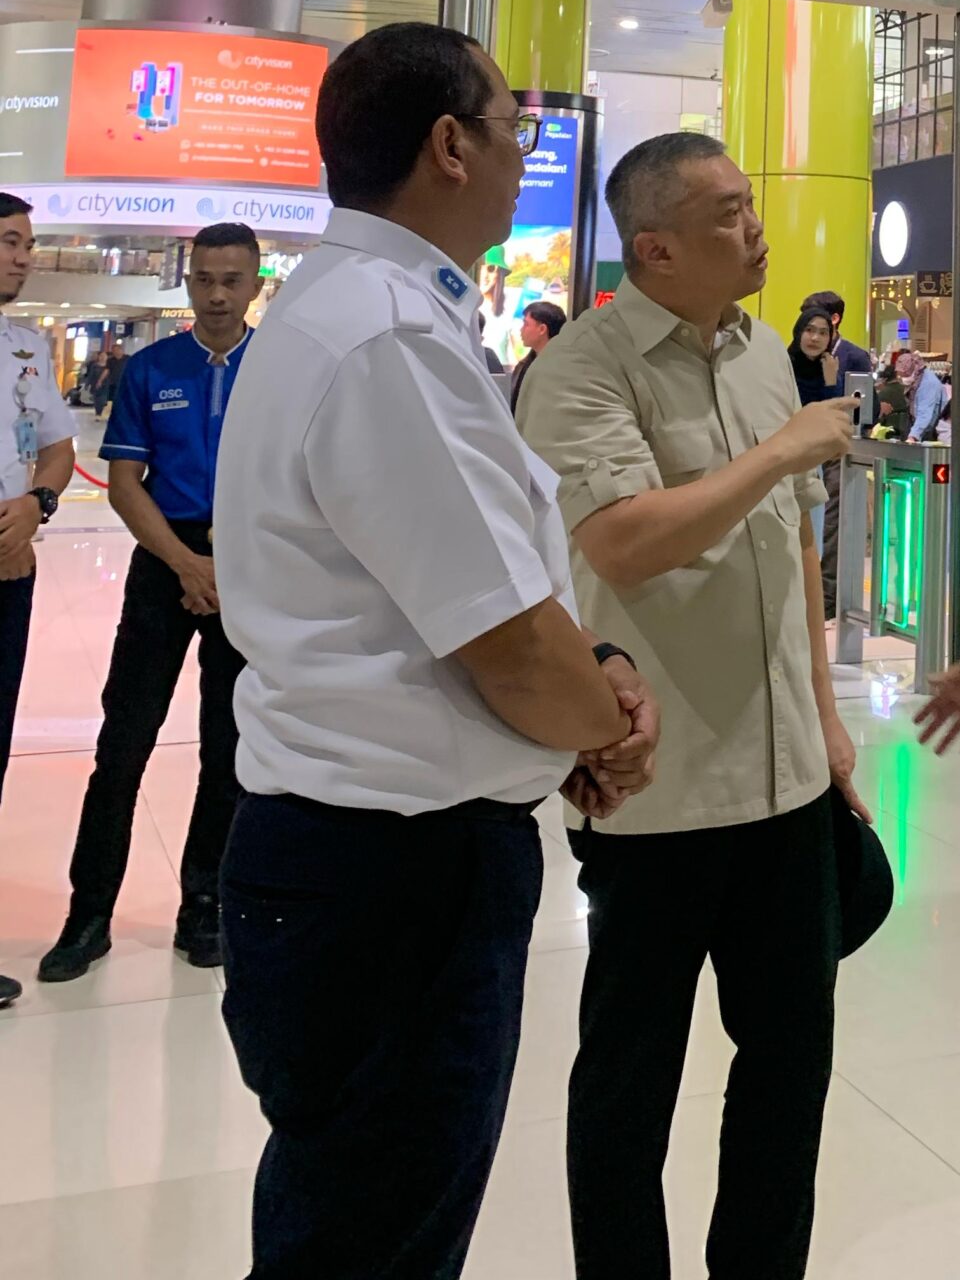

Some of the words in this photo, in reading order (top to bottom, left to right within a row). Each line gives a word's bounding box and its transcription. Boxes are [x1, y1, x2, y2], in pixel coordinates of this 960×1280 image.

[244, 56, 293, 69] cityvision
[191, 76, 217, 89] THE
[221, 78, 311, 97] OUT-OF-HOME
[195, 91, 224, 104] FOR
[228, 93, 305, 110] TOMORROW
[77, 193, 175, 220] cityvision
[232, 198, 314, 222] cityvision
[159, 388, 183, 400] OSC
